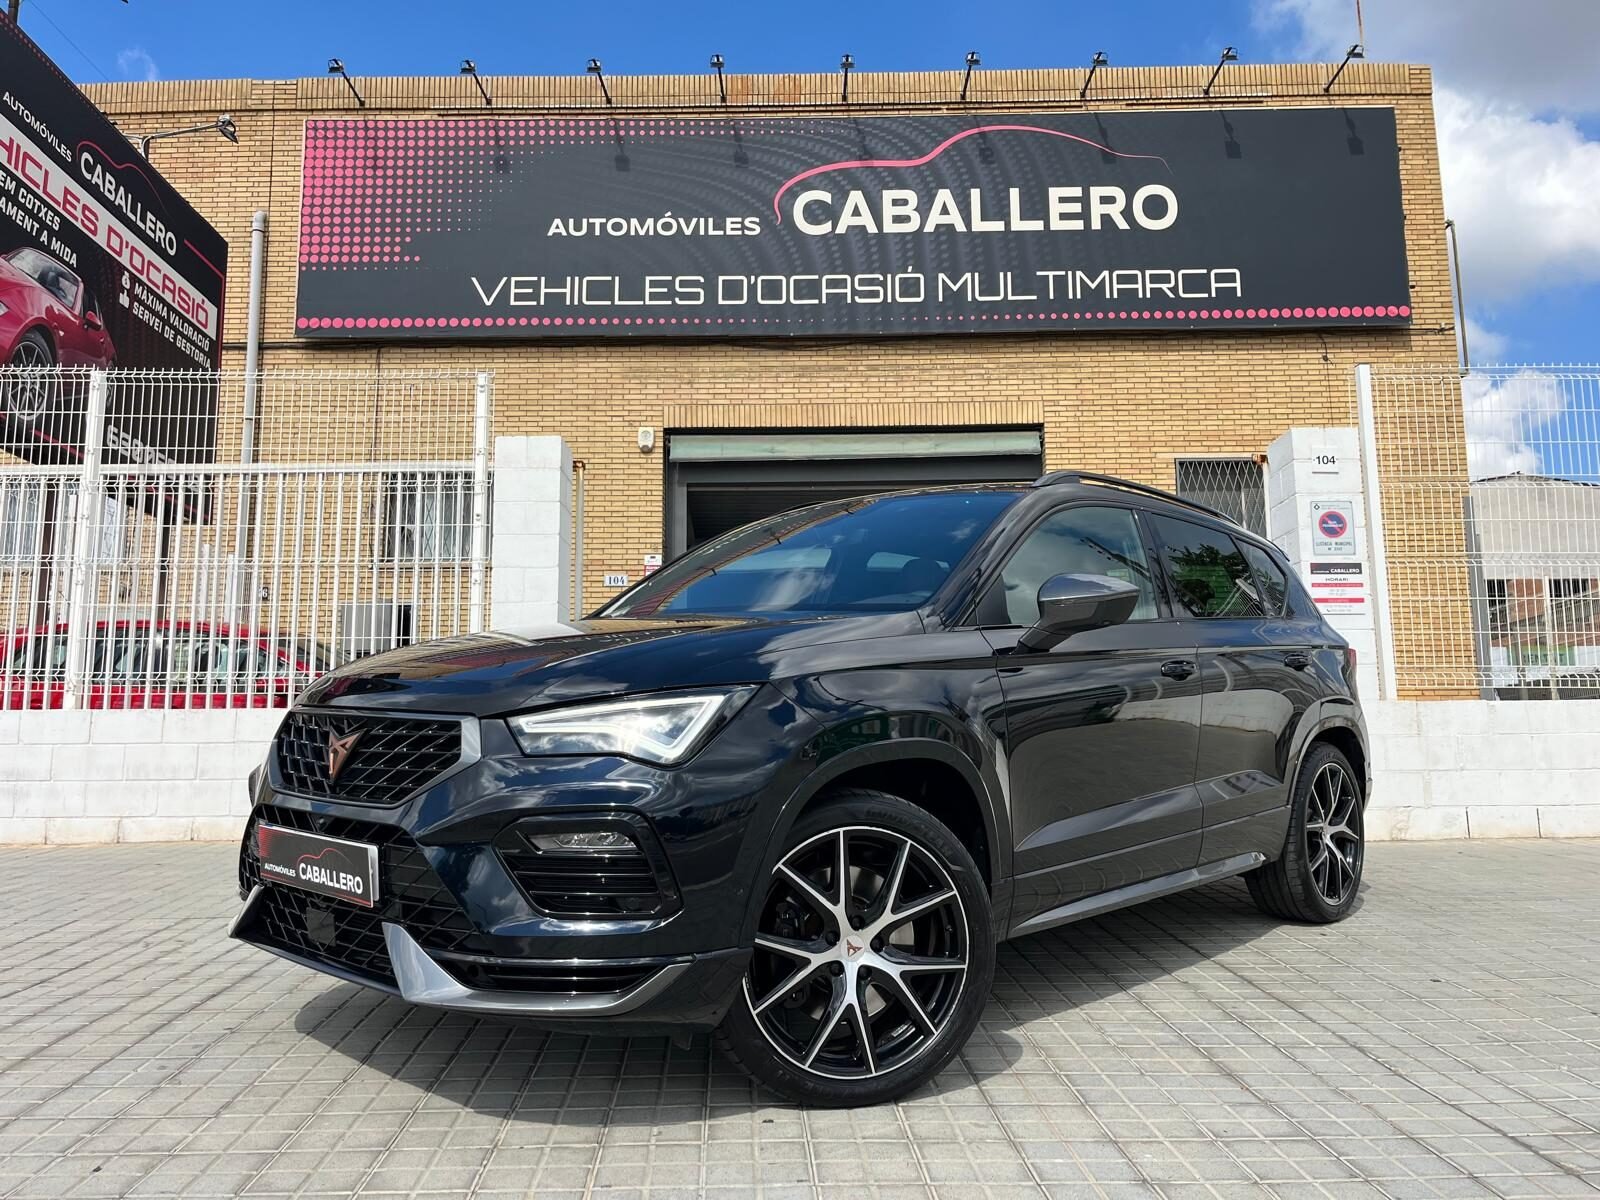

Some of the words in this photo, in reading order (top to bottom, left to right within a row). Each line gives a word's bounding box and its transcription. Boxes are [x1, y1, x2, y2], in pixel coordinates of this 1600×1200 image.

[3, 91, 72, 162] AUTOMÓVILES
[80, 151, 177, 256] CABALLERO
[18, 187, 61, 231] COTXES
[547, 211, 761, 237] AUTOMÓVILES
[792, 184, 1179, 236] CABALLERO
[40, 229, 48, 246] A
[50, 236, 77, 268] MIDA
[106, 223, 209, 330] D'OCASIÓ
[471, 275, 705, 306] VEHICLES
[717, 265, 925, 305] D'OCASIÓ
[938, 268, 1242, 302] MULTIMARCA
[132, 301, 162, 334] SERVEI
[164, 326, 176, 344] DE
[176, 335, 211, 369] GESTORIA
[134, 282, 168, 319] MÀXIMA
[169, 310, 210, 352] VALORACIÓ
[608, 576, 625, 585] 104
[264, 862, 296, 877] AUTOMÓVILES
[299, 862, 363, 894] CABALLERO
